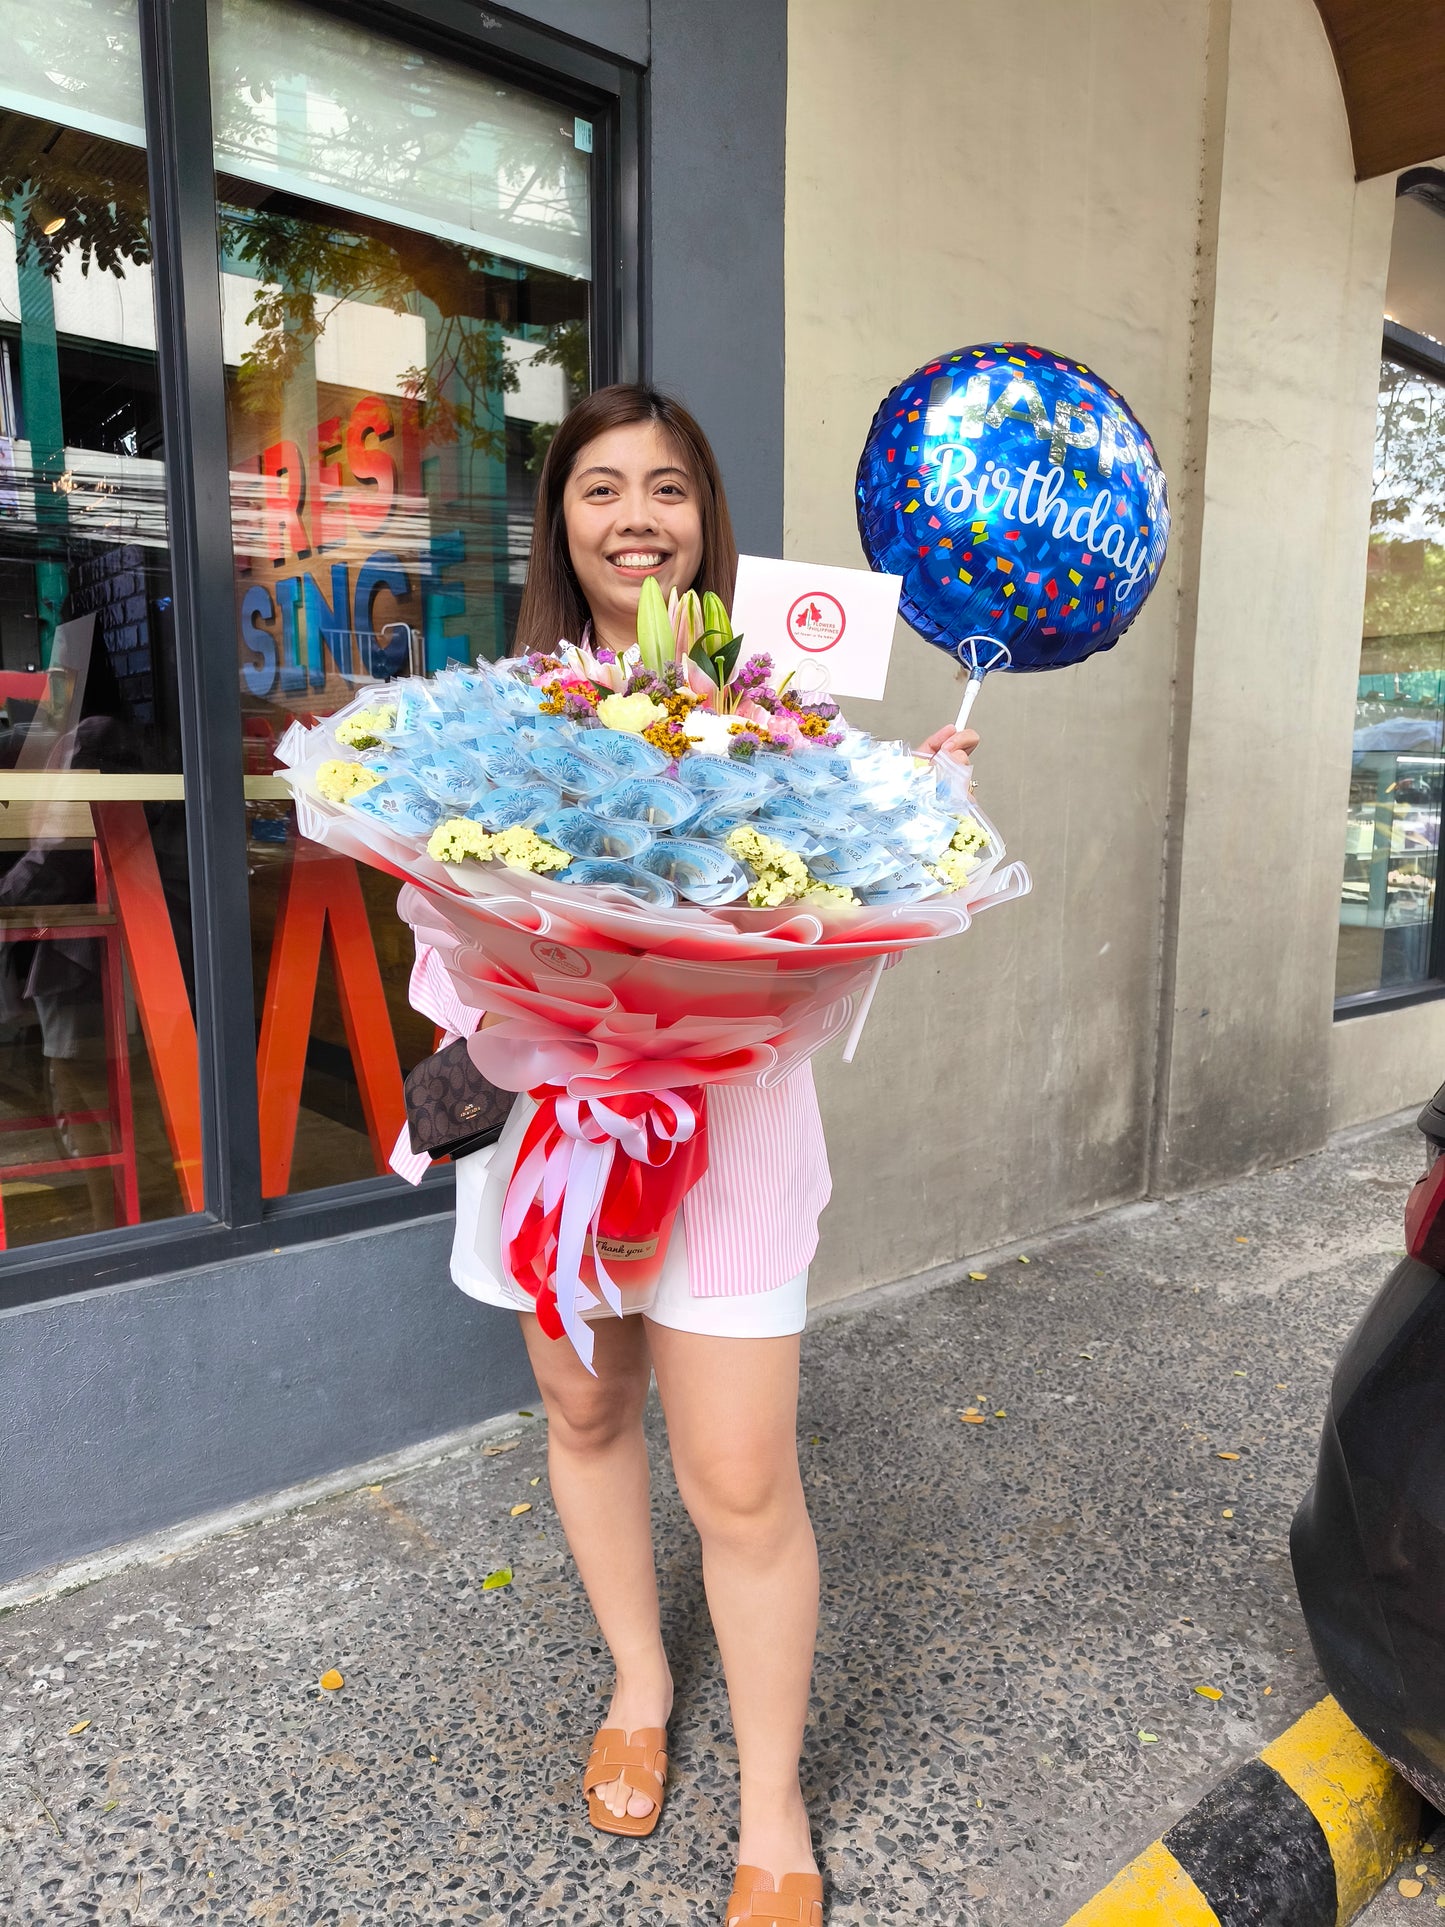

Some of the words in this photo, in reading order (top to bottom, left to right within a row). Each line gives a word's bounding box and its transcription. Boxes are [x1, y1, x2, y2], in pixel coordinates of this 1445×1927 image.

[923, 374, 1168, 522] HAPPY
[923, 442, 1148, 603] Birthday
[242, 530, 469, 696] SINCE
